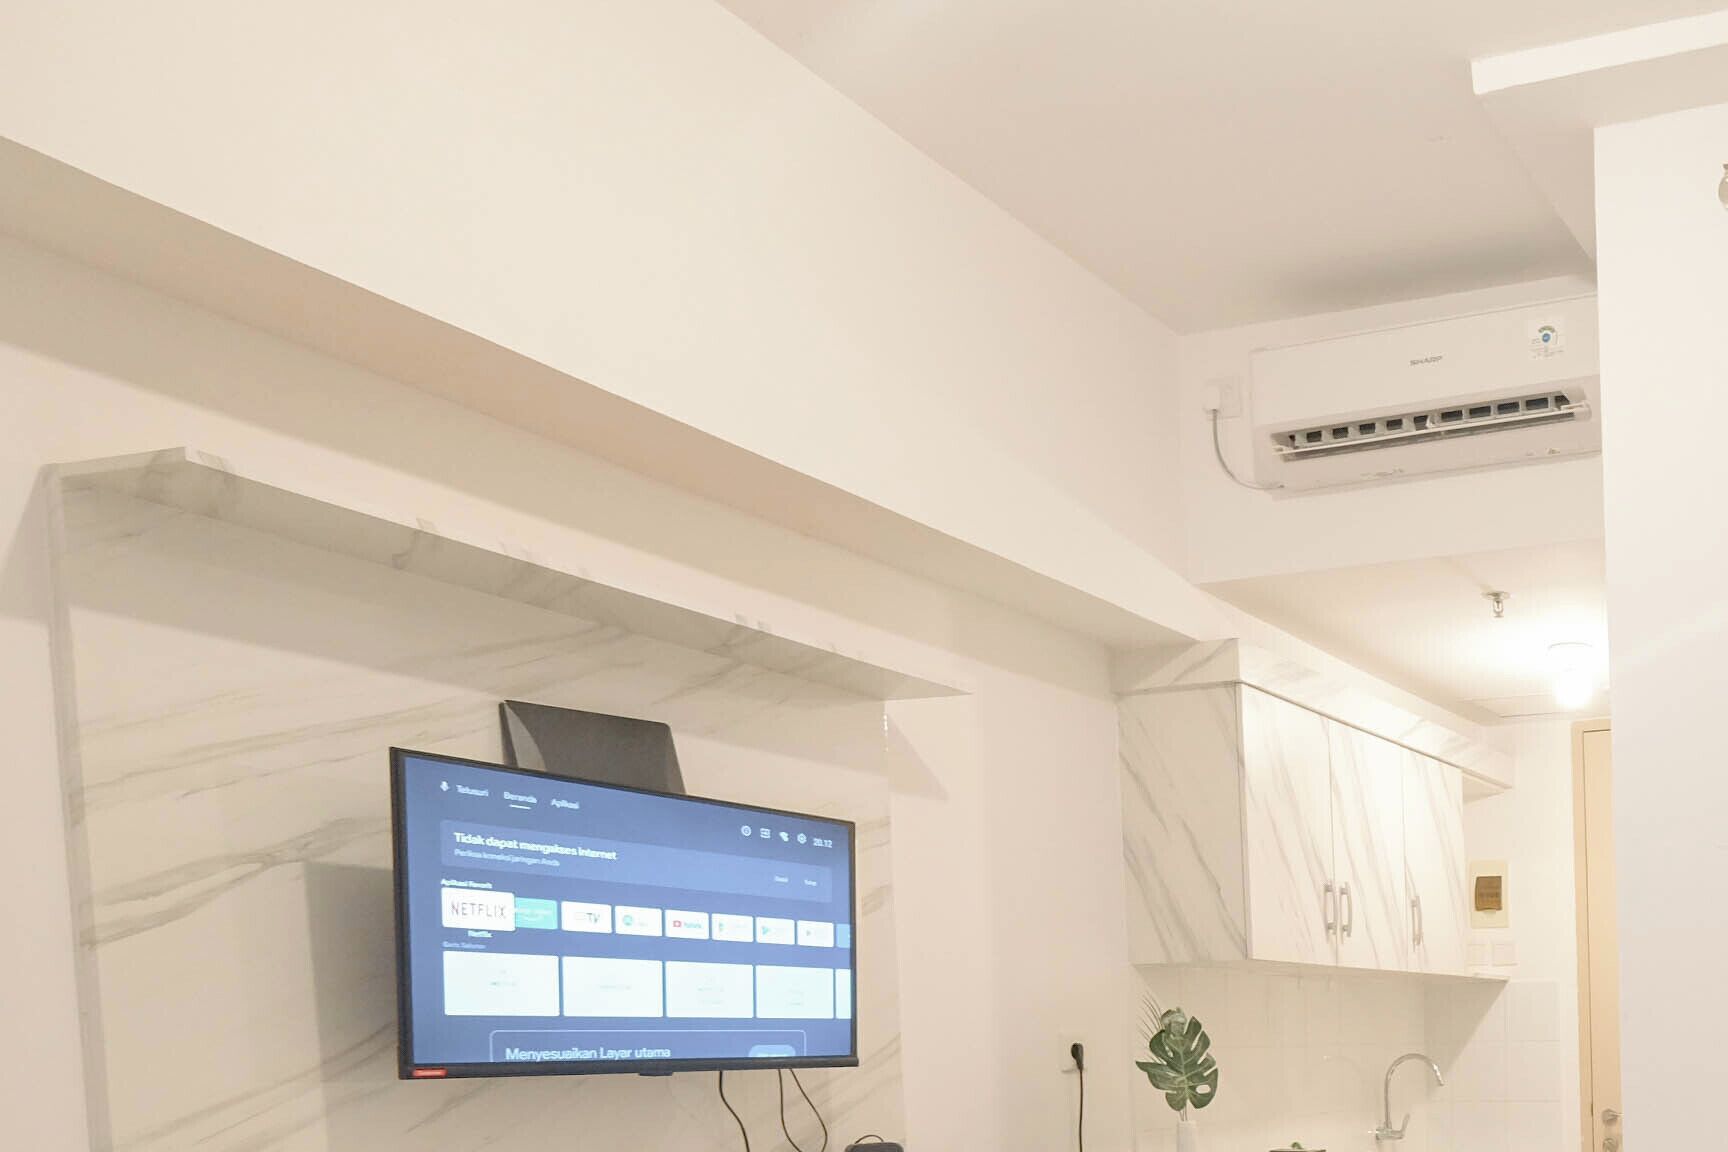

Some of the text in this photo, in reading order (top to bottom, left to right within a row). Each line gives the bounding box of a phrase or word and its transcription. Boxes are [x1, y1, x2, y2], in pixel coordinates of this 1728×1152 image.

[1410, 355, 1443, 366] SHARP
[503, 791, 538, 803] Beranda
[454, 832, 486, 846] Tidak
[486, 836, 519, 850] dapat
[519, 842, 577, 855] mengakses
[451, 901, 507, 919] NETFLIX
[586, 912, 601, 923] TV
[505, 1046, 671, 1062] Menyesuaikan Layar utama
